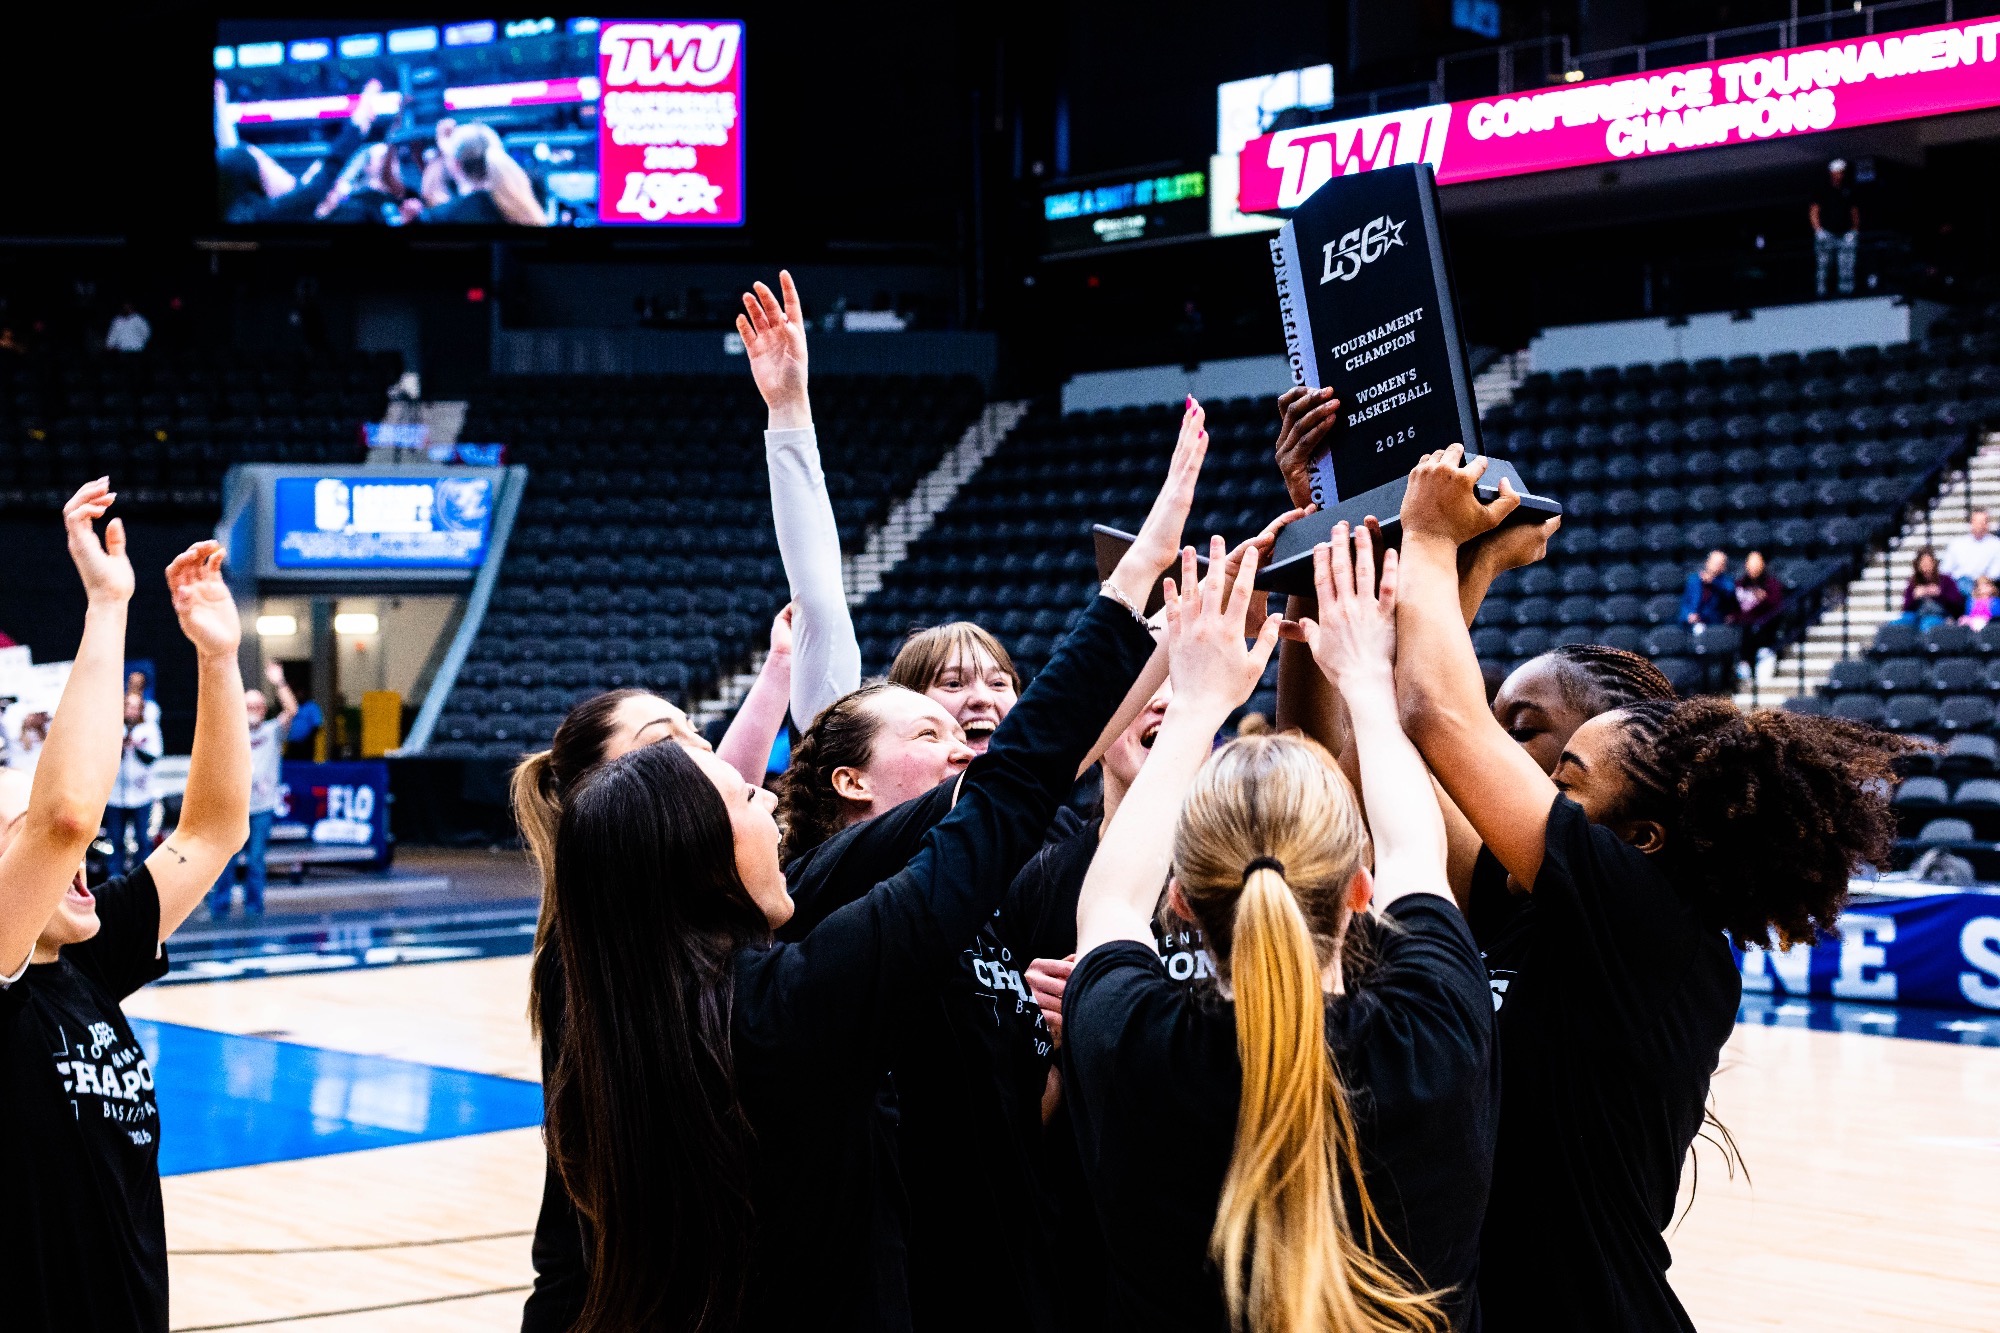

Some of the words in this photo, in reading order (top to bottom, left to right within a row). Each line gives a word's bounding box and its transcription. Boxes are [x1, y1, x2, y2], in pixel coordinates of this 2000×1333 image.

[600, 24, 741, 86] TWU
[1468, 68, 1713, 140] CONFERENCE
[1718, 22, 2000, 102] TOURNAMENT
[1606, 88, 1837, 157] CHAMPIONS
[1320, 215, 1390, 285] LSC
[1269, 235, 1305, 386] CONFERENCE
[1332, 307, 1423, 359] TOURNAMENT
[1345, 330, 1416, 371] CHAMPION
[1348, 382, 1432, 427] BASKETBALL
[1356, 368, 1417, 404] WOMEN'S
[1376, 426, 1416, 453] 2026
